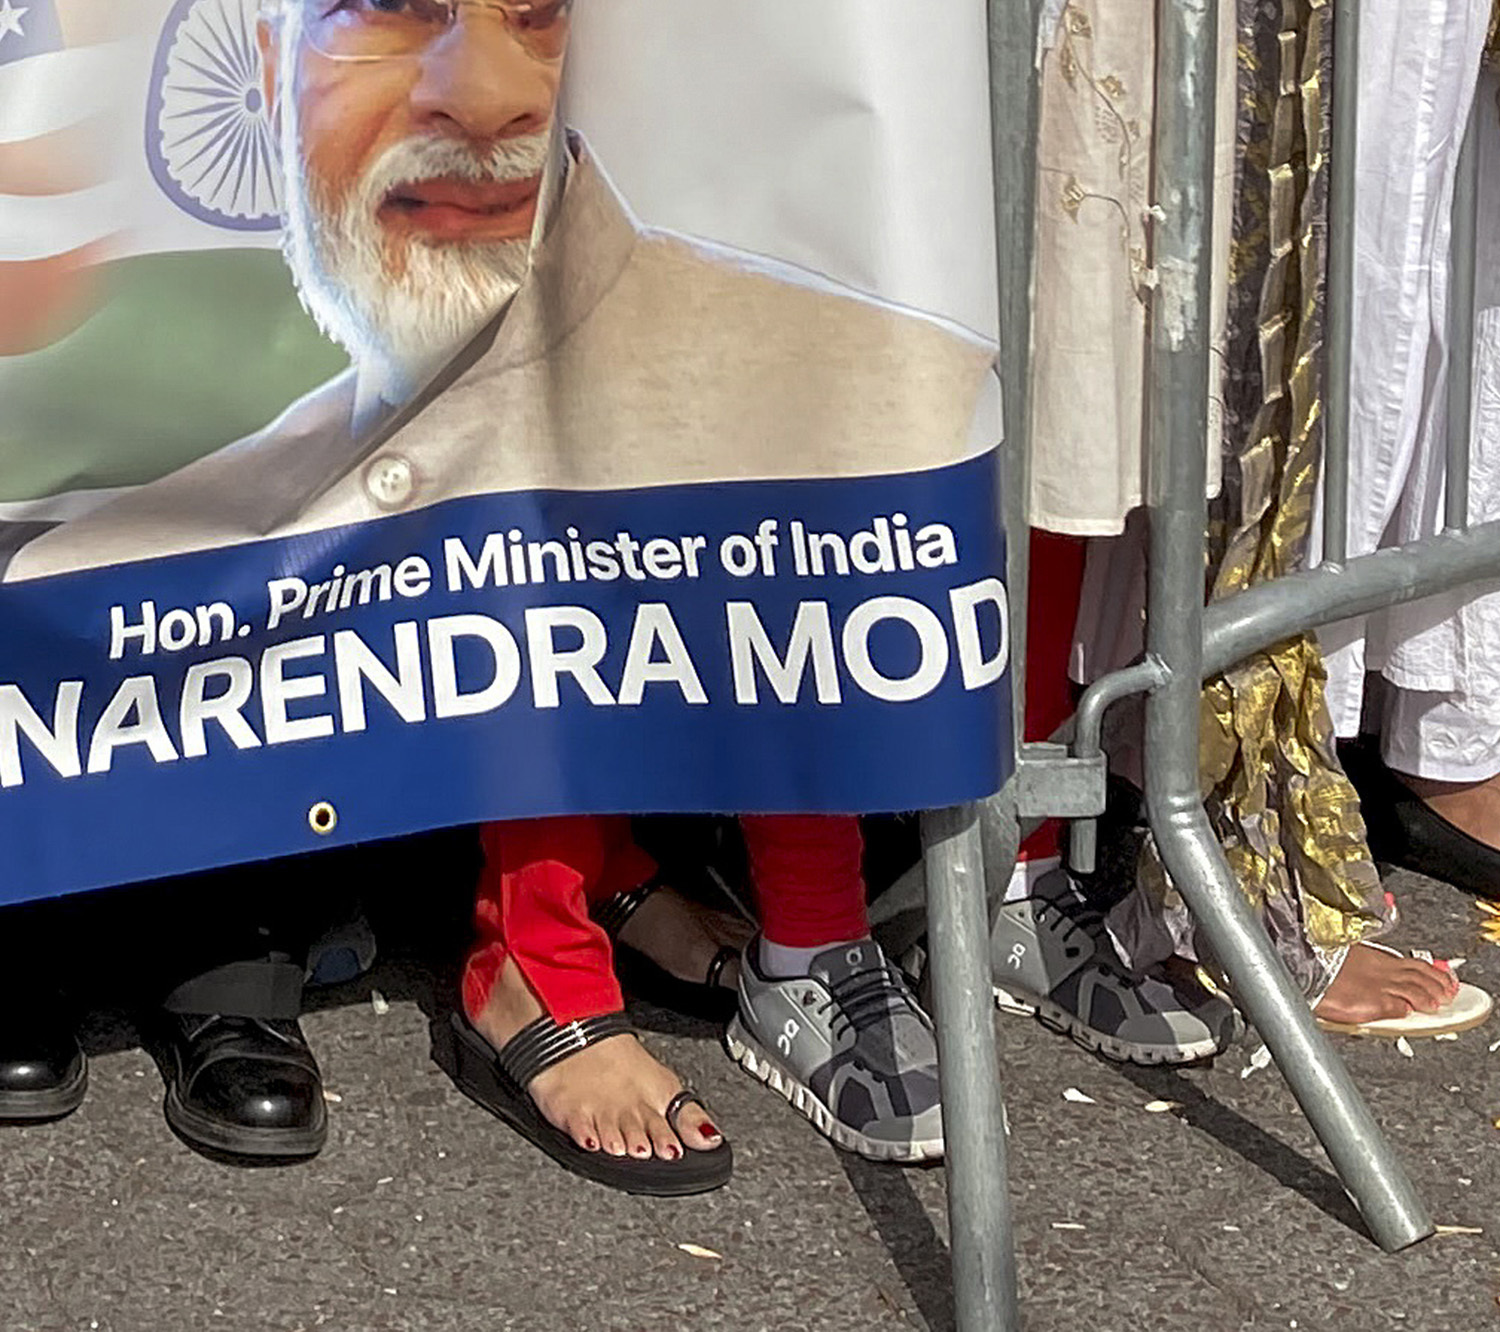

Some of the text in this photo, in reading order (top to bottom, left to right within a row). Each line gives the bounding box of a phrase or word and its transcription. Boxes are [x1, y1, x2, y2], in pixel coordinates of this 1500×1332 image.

[109, 514, 958, 660] Hon. Prime Minister of India
[727, 577, 1010, 707] MOD
